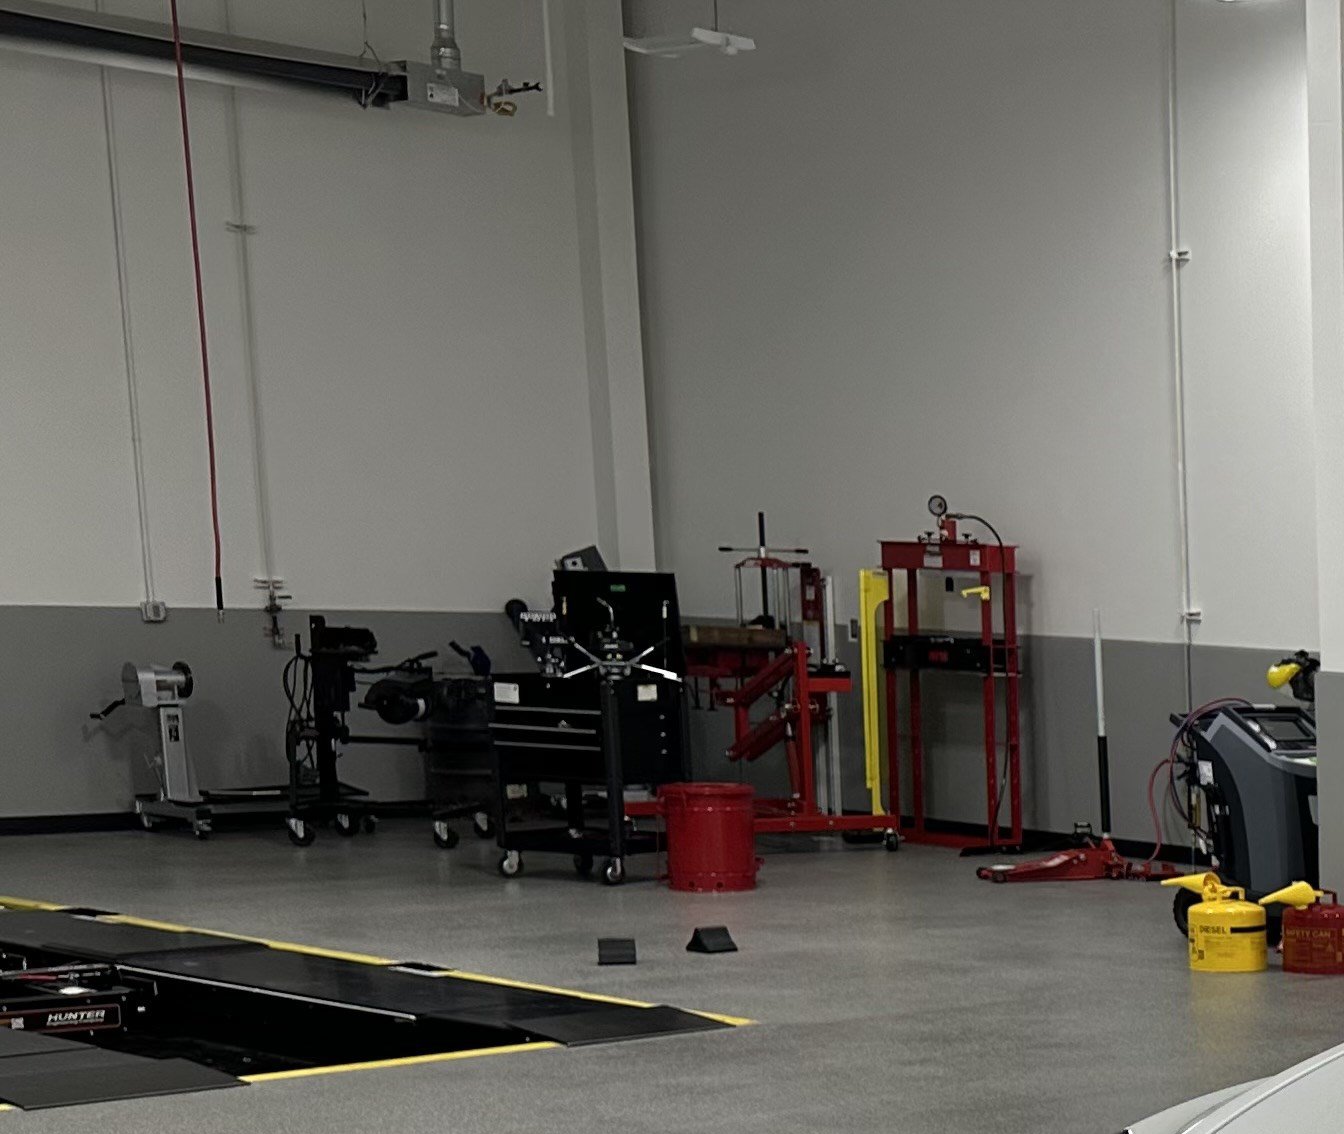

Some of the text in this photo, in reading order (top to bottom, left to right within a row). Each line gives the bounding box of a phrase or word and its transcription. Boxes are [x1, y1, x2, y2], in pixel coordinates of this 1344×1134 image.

[1199, 925, 1227, 935] DIESEL
[1312, 928, 1332, 938] CAN
[48, 1009, 106, 1022] HUNTER
